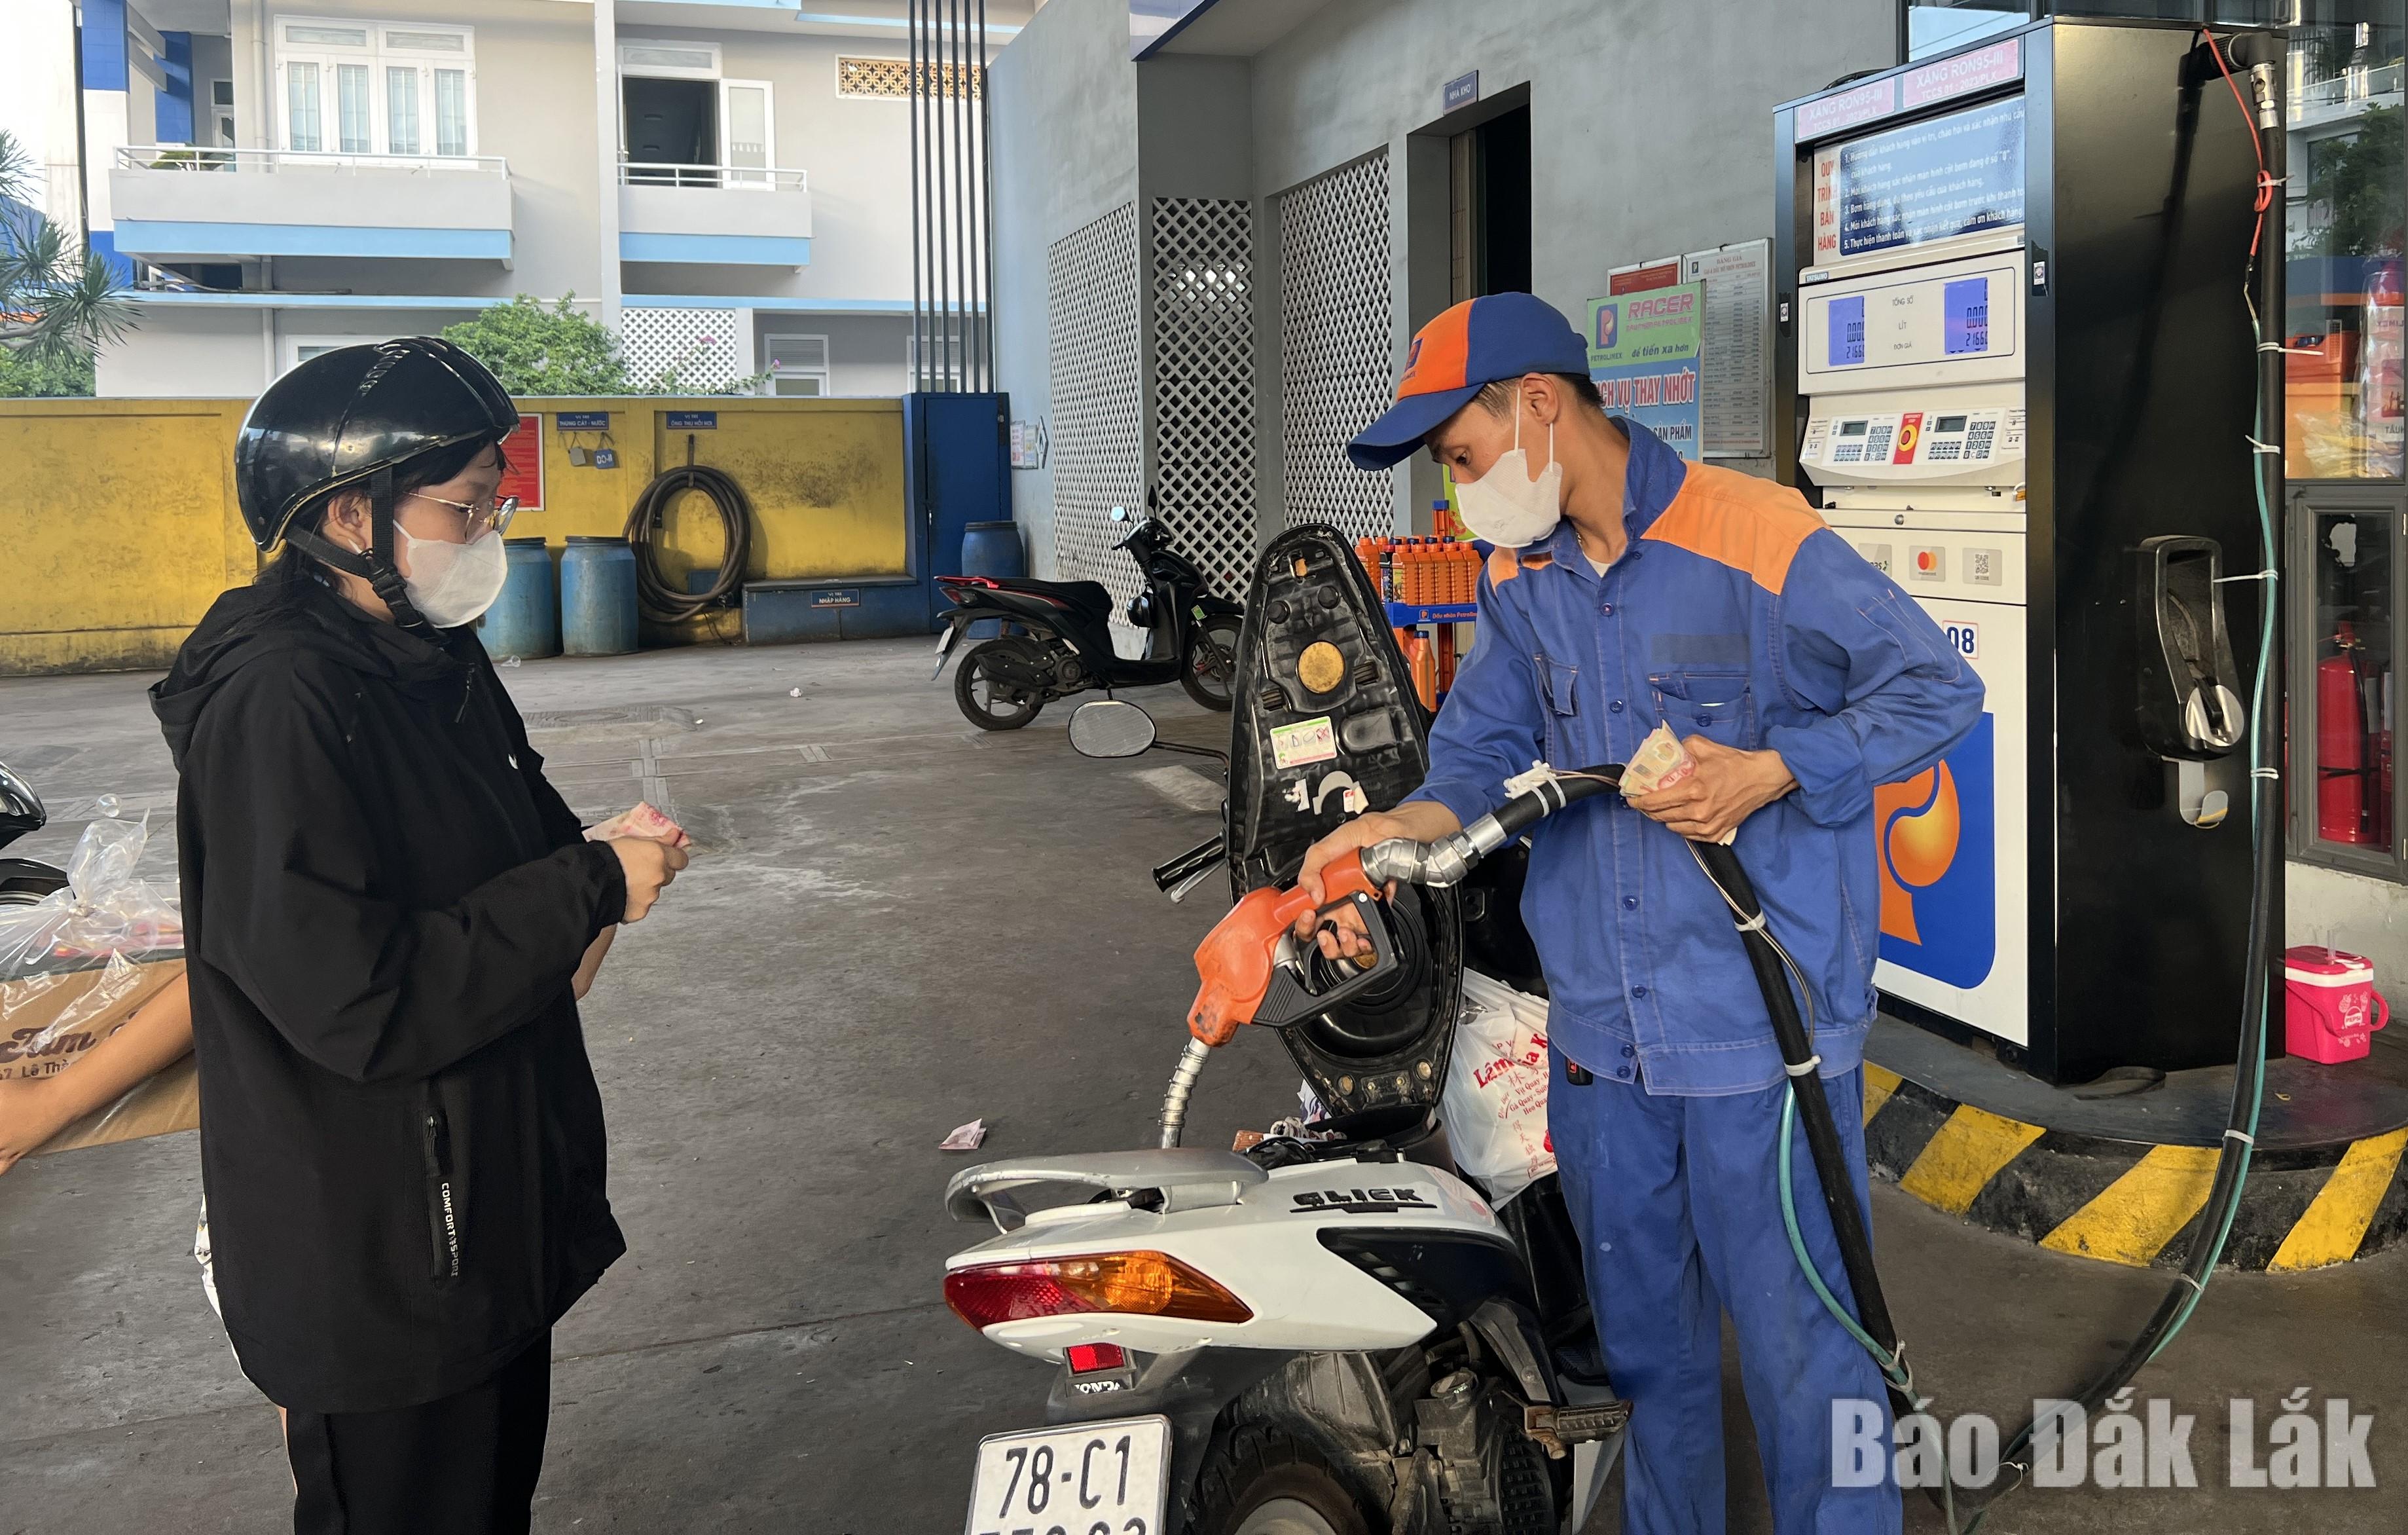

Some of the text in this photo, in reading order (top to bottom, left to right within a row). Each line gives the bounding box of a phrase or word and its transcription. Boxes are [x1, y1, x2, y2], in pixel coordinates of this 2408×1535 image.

[1461, 84, 1471, 96] KHO
[1817, 232, 1837, 251] HÀNG
[1844, 238, 1850, 250] 5.
[1876, 231, 1891, 243] thanh
[1628, 293, 1693, 320] RACER
[1662, 344, 1673, 354] xa
[1675, 344, 1689, 352] hơn
[1616, 378, 1632, 413] VỤ
[1634, 375, 1661, 406] THAY
[1663, 367, 1695, 404] NHỚT
[1946, 627, 1975, 654] 08
[1473, 1058, 1515, 1089] Lâm
[1525, 1077, 1540, 1090] Quay
[1518, 1094, 1533, 1107] Quay
[999, 1435, 1131, 1519] 78-C1
